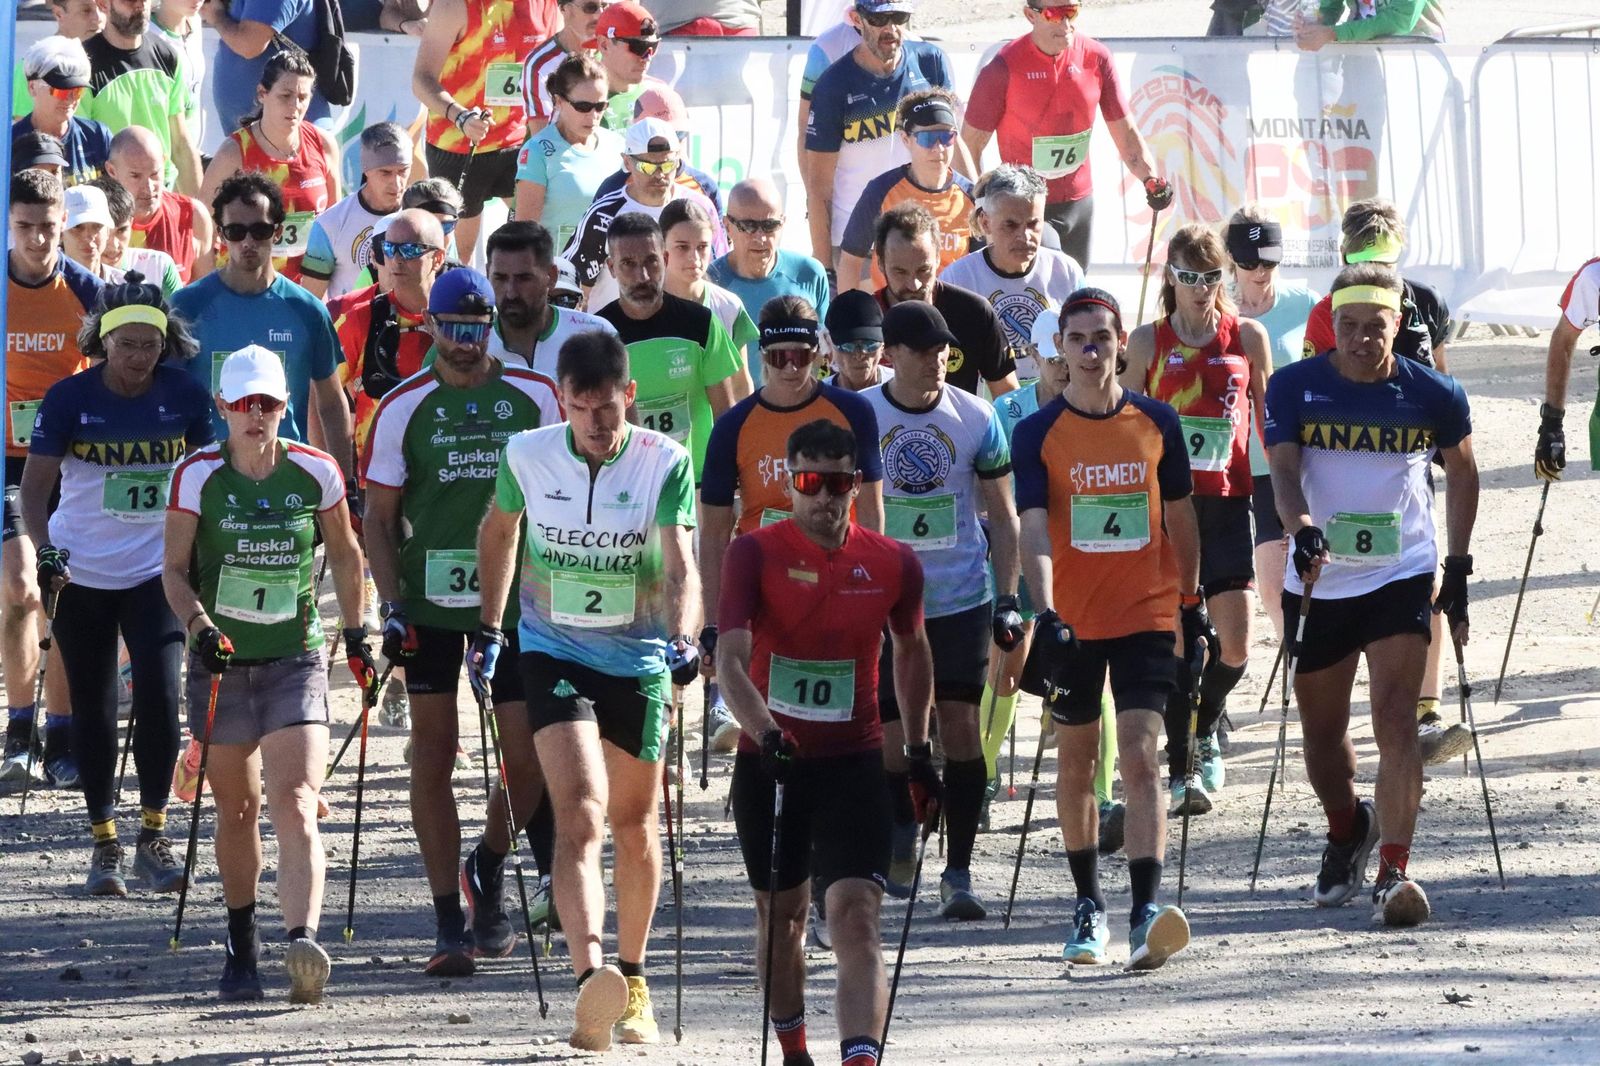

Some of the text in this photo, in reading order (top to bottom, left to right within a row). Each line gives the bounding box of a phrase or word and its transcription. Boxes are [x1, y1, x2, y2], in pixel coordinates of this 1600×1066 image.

[503, 76, 521, 95] 6
[1051, 147, 1077, 168] 76
[274, 225, 298, 245] 3
[269, 329, 293, 342] fmm
[773, 327, 811, 335] LURBEL
[6, 333, 66, 353] FEMECV
[644, 412, 674, 433] 18
[1190, 433, 1205, 456] 9
[448, 448, 500, 466] Euskal
[1085, 462, 1148, 488] FEMECV
[127, 485, 158, 509] 13
[913, 513, 929, 537] 6
[1103, 512, 1122, 537] 4
[237, 537, 295, 553] Euskal
[1356, 530, 1373, 553] 8
[543, 548, 643, 575] ANDALUZA
[449, 567, 481, 592] 36
[252, 588, 266, 610] 1
[585, 590, 602, 614] 2
[794, 678, 832, 706] 10
